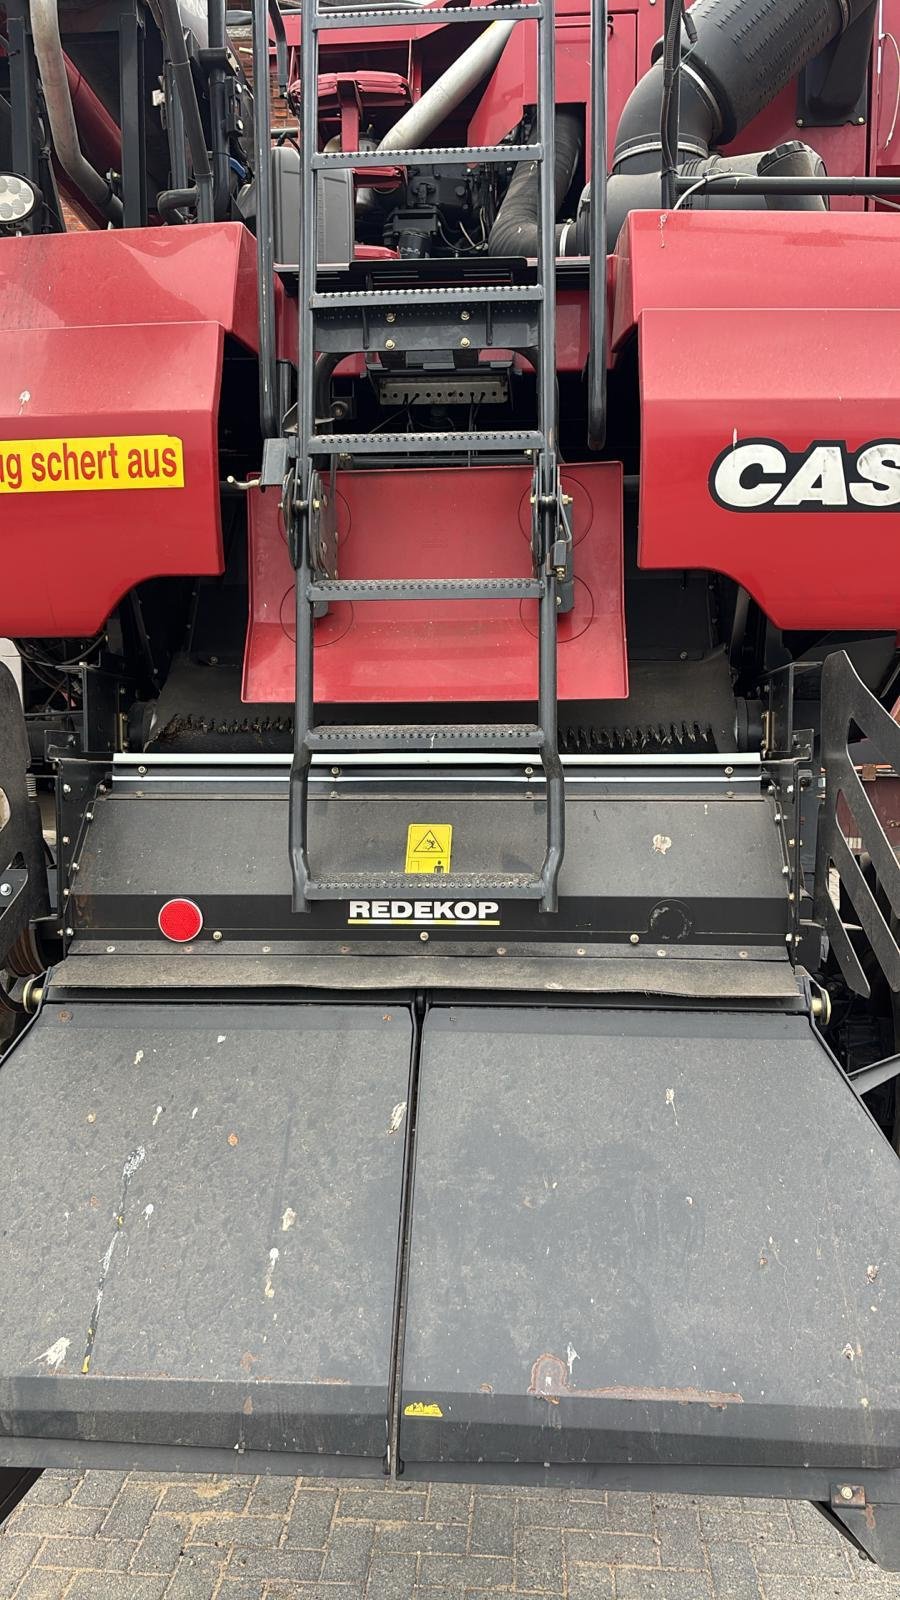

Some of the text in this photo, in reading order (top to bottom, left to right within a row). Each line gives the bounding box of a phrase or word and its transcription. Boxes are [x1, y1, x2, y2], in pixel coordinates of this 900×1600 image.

[0, 442, 177, 489] g schert aus
[714, 443, 900, 507] CAS
[349, 901, 499, 919] REDEKOP
